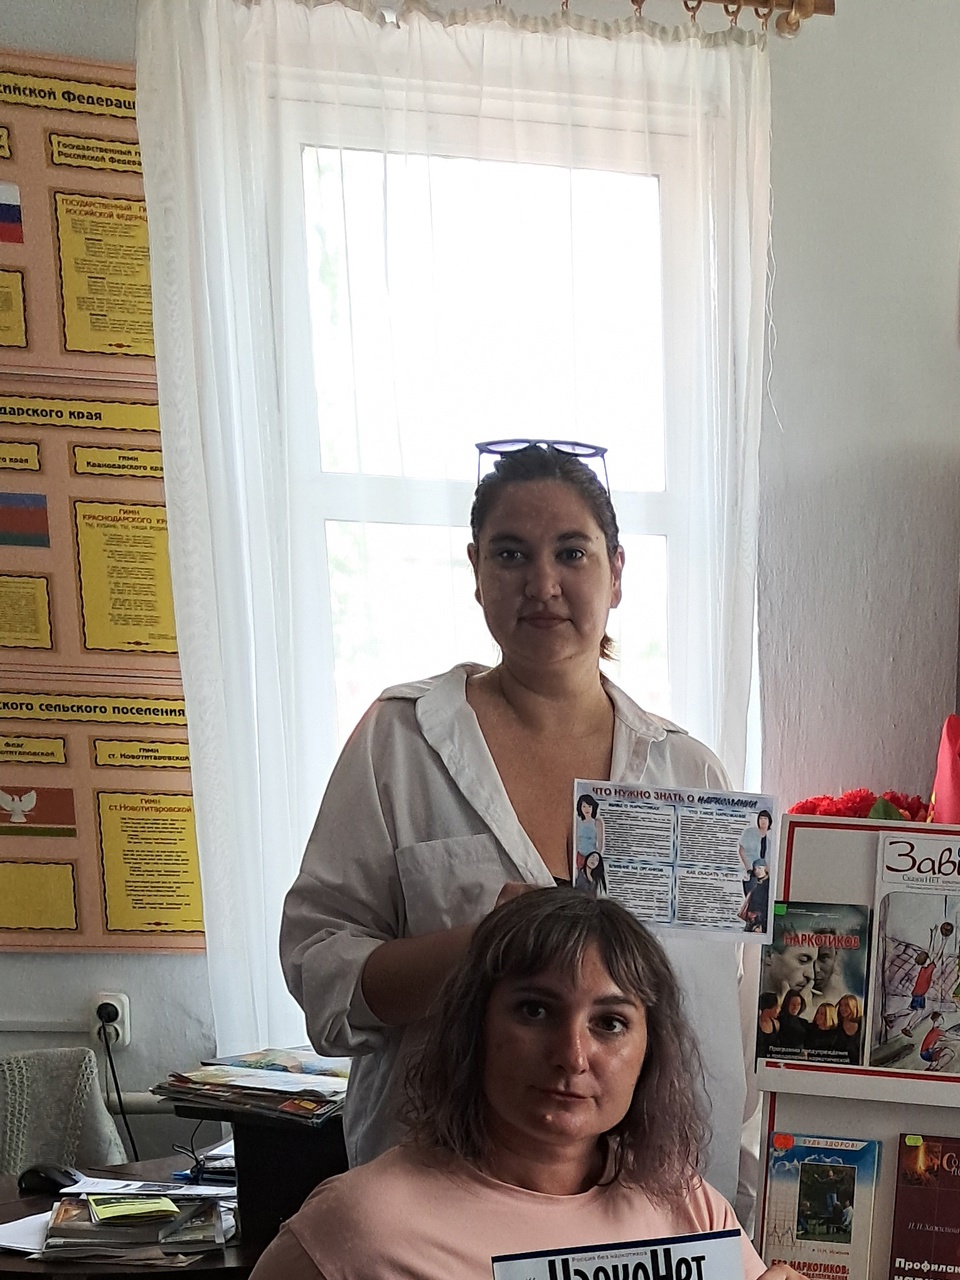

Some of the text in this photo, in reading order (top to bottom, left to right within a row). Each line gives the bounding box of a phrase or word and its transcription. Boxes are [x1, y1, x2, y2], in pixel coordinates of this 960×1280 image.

[68, 410, 103, 421] края
[39, 702, 186, 718] сельского поселения
[614, 788, 651, 800] НУЖНО
[653, 791, 685, 803] ЗНАТЬ
[687, 794, 695, 803] О
[783, 931, 861, 951] НАРКОТИКОВ
[803, 1138, 859, 1150] БУДЬ ЗДОРОВ!
